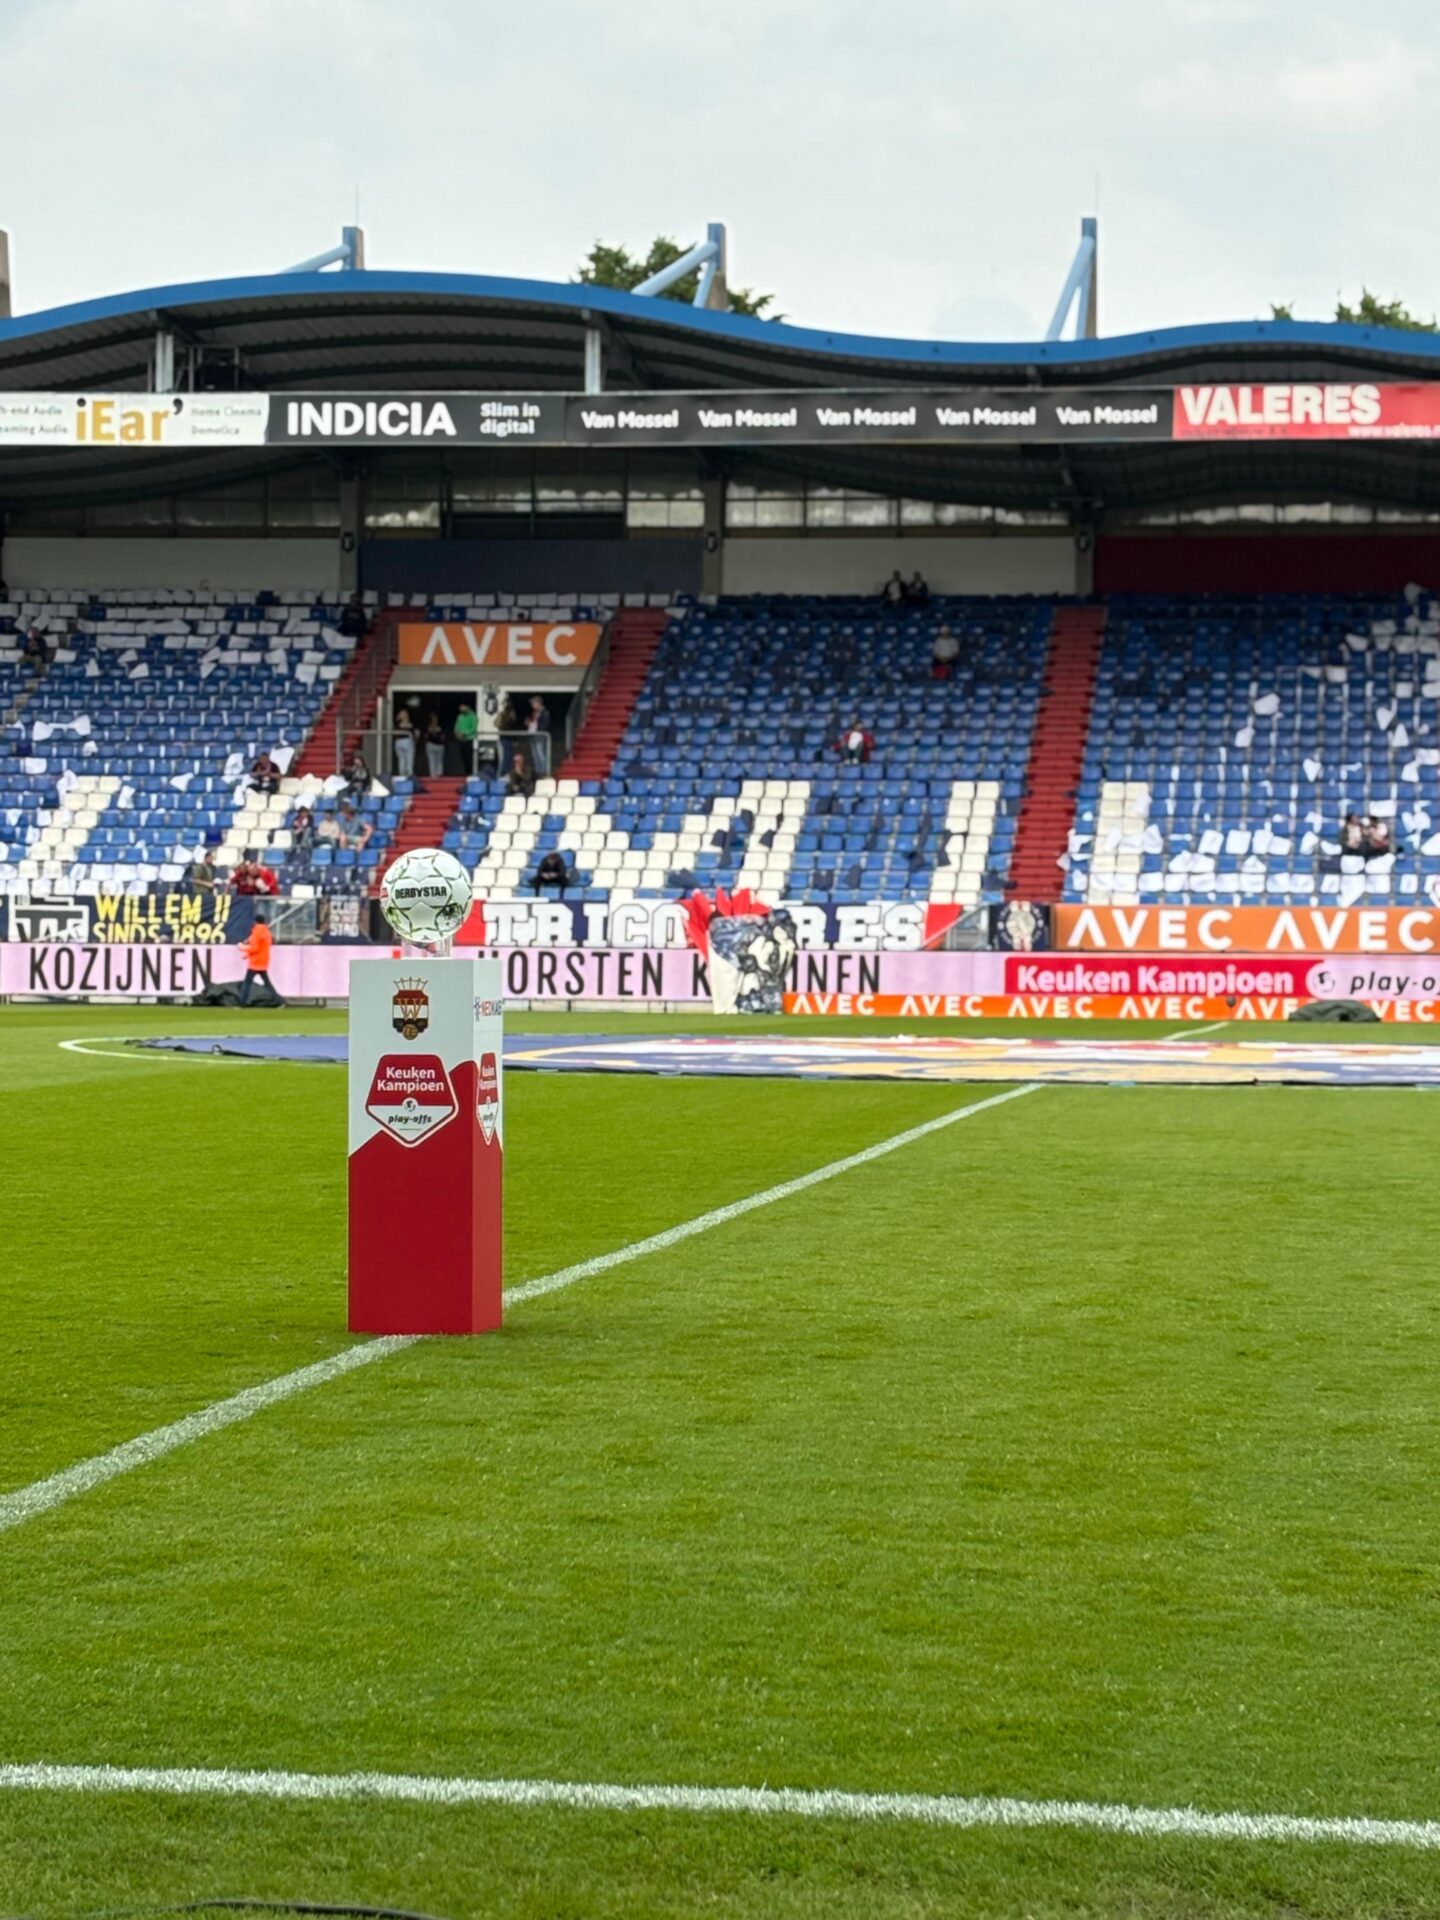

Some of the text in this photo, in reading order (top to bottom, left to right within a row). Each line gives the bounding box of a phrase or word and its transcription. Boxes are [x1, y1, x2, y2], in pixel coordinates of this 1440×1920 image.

[480, 402, 541, 417] Slim in
[1056, 404, 1158, 424] Van Mossel
[1180, 384, 1381, 425] VALERES
[287, 401, 458, 436] INDICIA
[581, 409, 680, 428] Van Mossel
[698, 408, 798, 427] Van Mossel
[816, 407, 917, 426] Van Mossel
[936, 406, 1037, 426] Van Mossel
[480, 418, 536, 437] digital
[420, 625, 577, 665] AVEC
[395, 886, 448, 899] DERBYSTAR
[94, 894, 202, 925] WILLEM
[1067, 908, 1233, 950] AVEC
[1265, 910, 1435, 952] AVEC
[29, 947, 212, 991] KOZIJNEN
[1018, 963, 1440, 998] Keuken Kampioen play-o
[793, 995, 1434, 1021] AVEC AVEC AVEC AVEC AVE VEC
[386, 1066, 436, 1079] Keuken
[377, 1080, 445, 1094] Kampioen
[388, 1113, 432, 1125] play-offs
